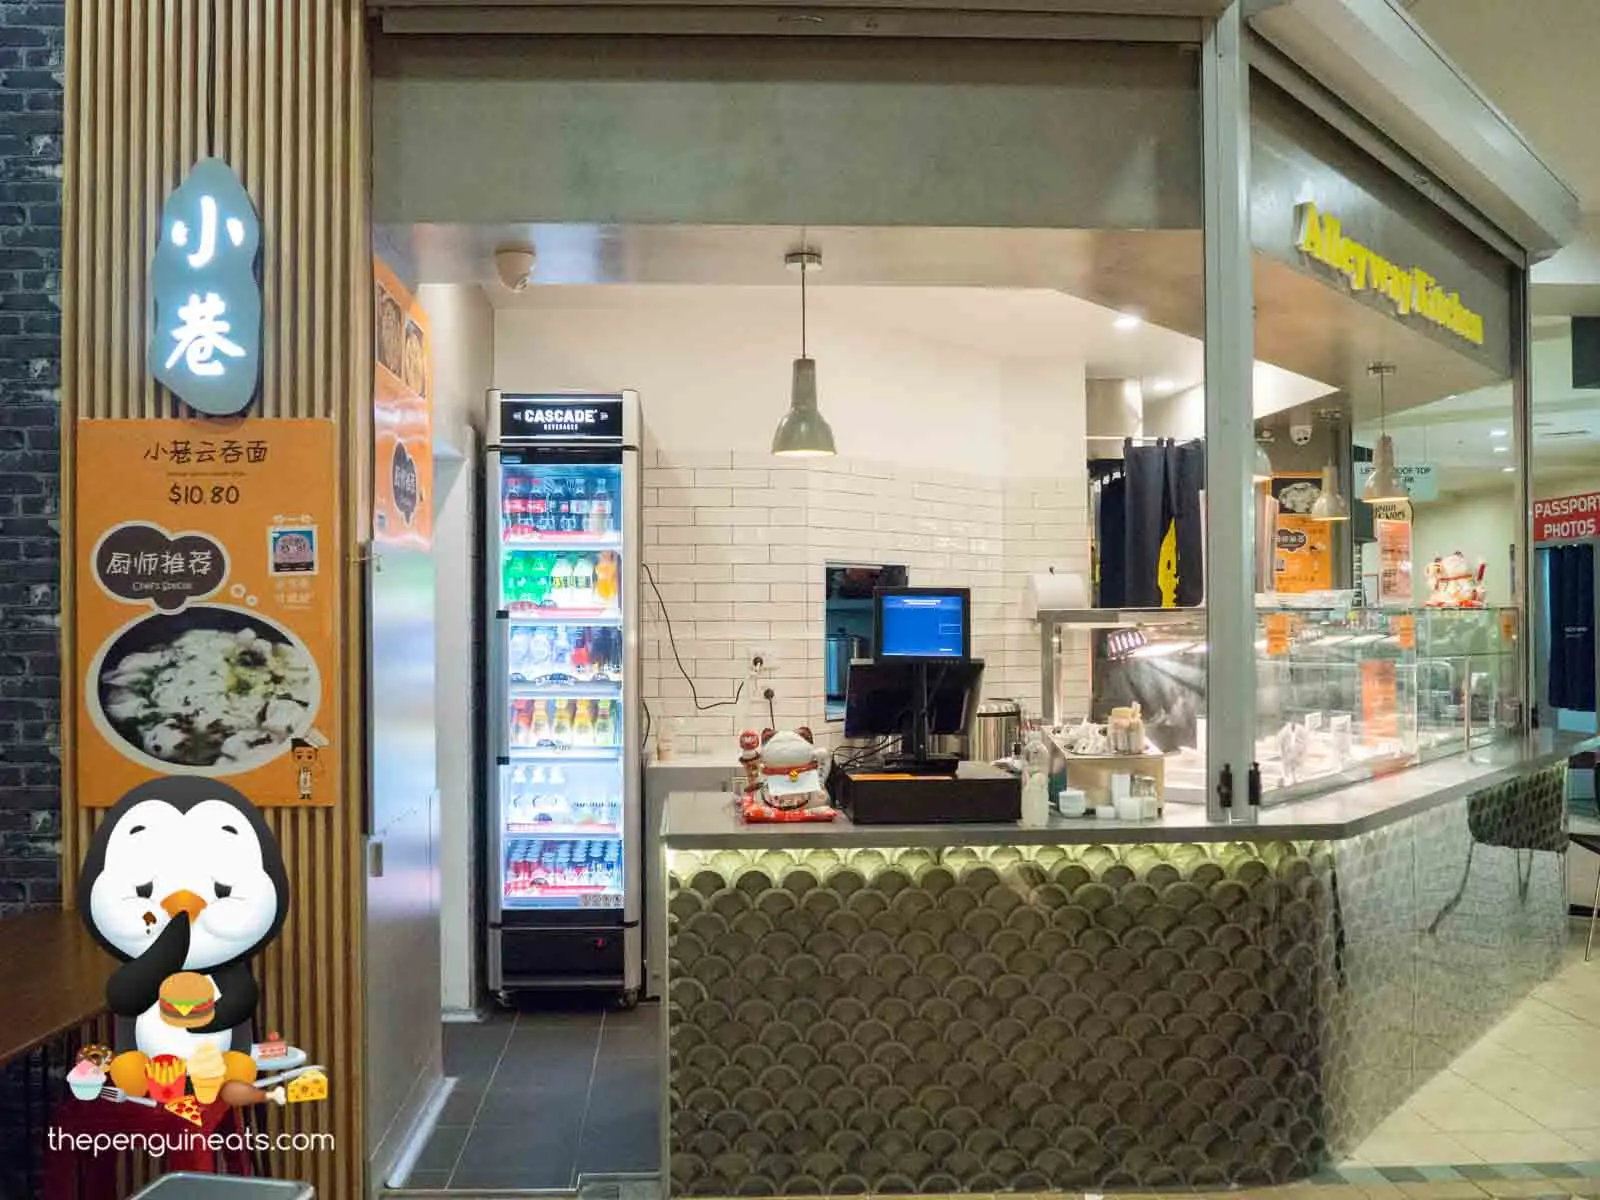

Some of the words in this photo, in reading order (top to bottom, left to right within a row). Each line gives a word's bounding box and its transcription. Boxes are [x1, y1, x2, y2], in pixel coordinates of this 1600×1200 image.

[164, 194, 248, 377] 小巷
[524, 408, 596, 423] CASCADE
[543, 423, 579, 431] BEVERAGES
[143, 440, 269, 465] 小巷云吞面
[168, 483, 240, 505] $10.80
[1543, 518, 1597, 538] PHOTOS
[106, 550, 213, 576] 厨师推荐
